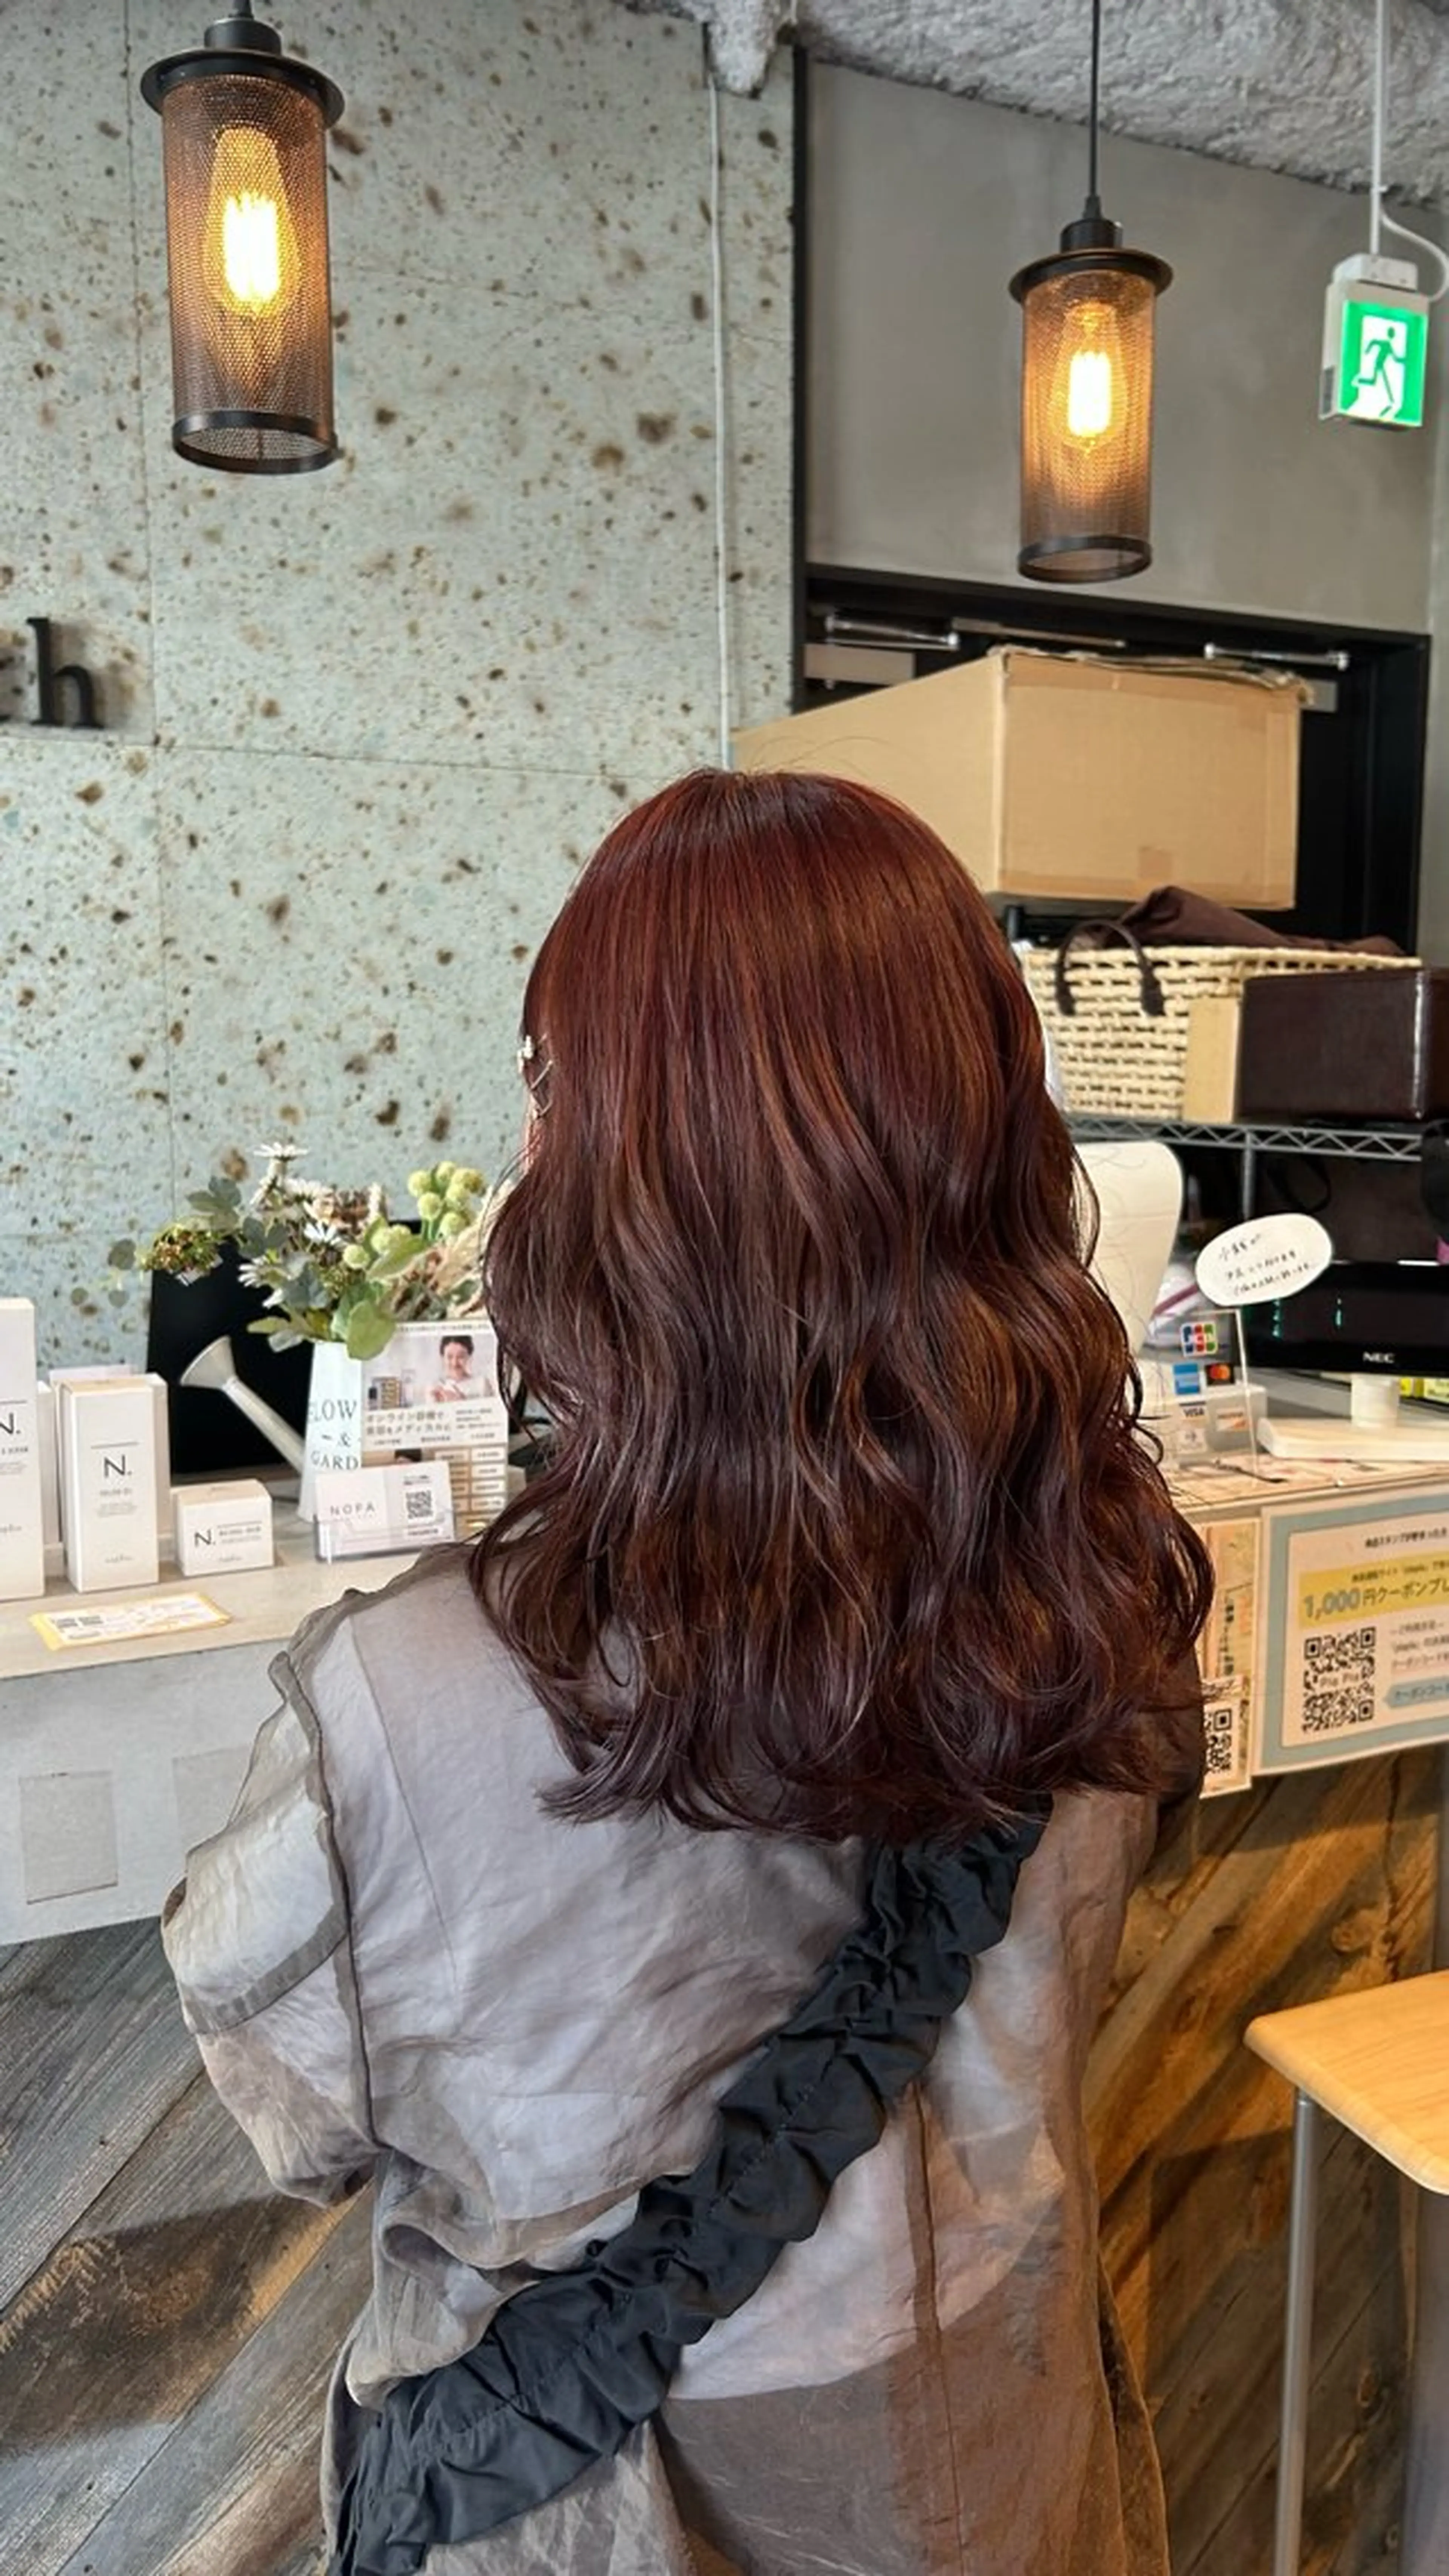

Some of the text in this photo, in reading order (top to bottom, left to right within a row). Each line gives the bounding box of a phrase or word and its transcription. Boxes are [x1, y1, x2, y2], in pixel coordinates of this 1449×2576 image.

[1363, 1351, 1395, 1364] NEC
[1184, 1407, 1205, 1418] VISA
[104, 1454, 132, 1478] N.
[194, 1529, 216, 1547] N.
